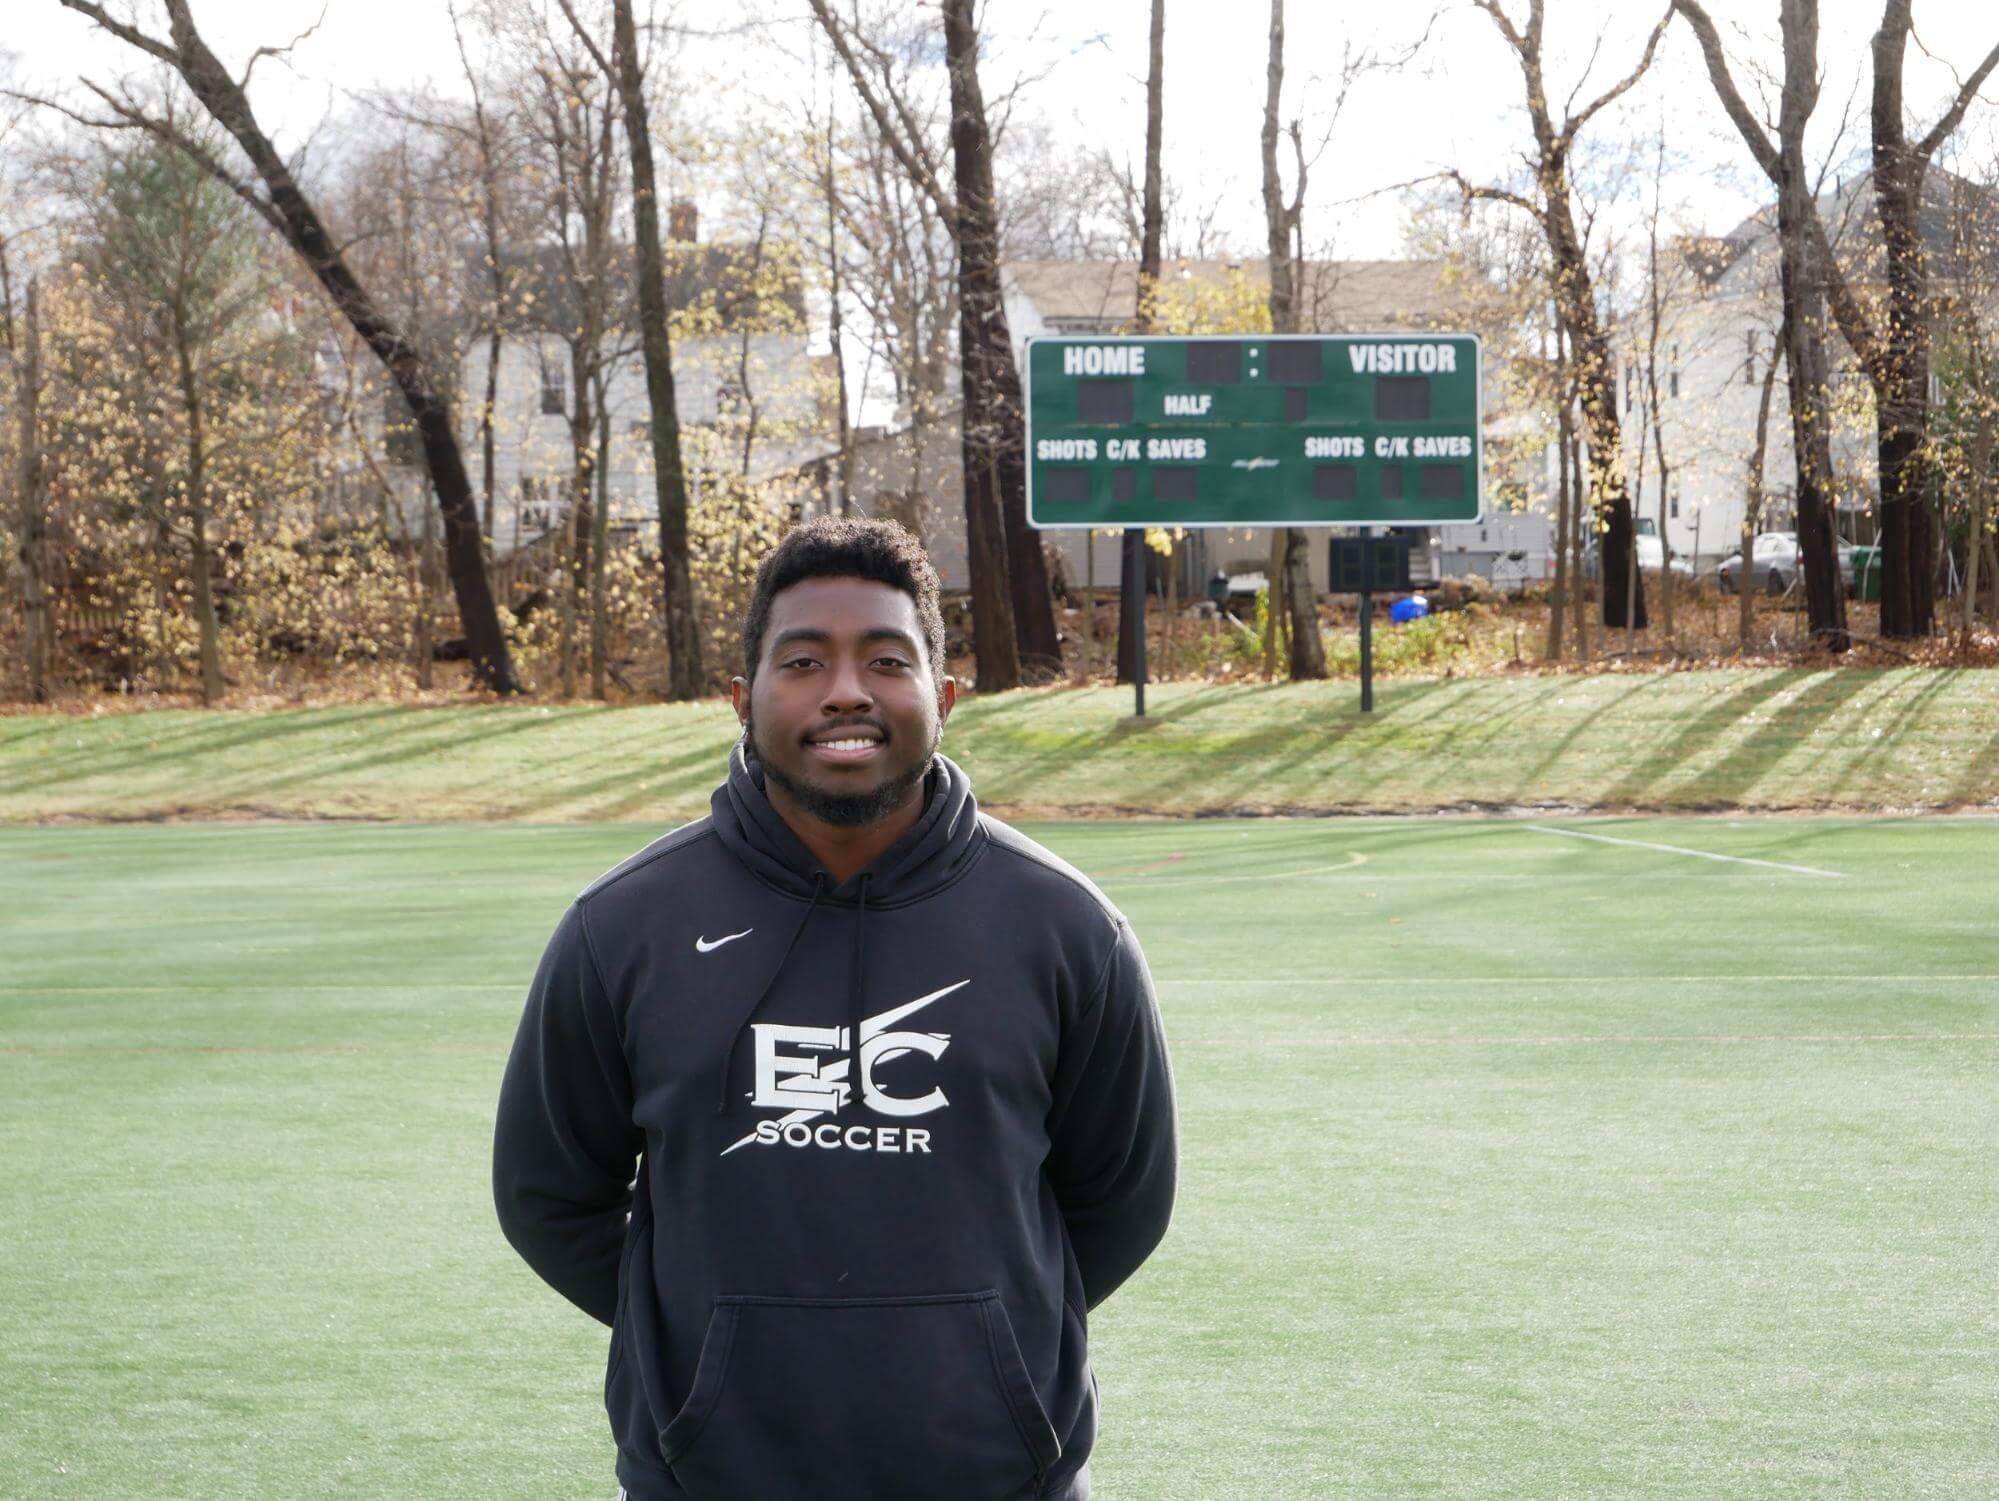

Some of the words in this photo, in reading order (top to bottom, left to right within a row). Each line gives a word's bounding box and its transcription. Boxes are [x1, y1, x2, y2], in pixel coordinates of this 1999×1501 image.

[1064, 345, 1145, 375] HOME
[1348, 344, 1457, 373] VISITOR
[1164, 394, 1212, 415] HALF
[1037, 438, 1098, 460] SHOTS
[1106, 439, 1141, 460] C/K
[1147, 438, 1206, 459] SAVES
[1304, 436, 1365, 458] SHOTS
[1374, 436, 1409, 458] C/K
[1413, 436, 1472, 457] SAVES
[756, 1119, 932, 1153] SOCCER
